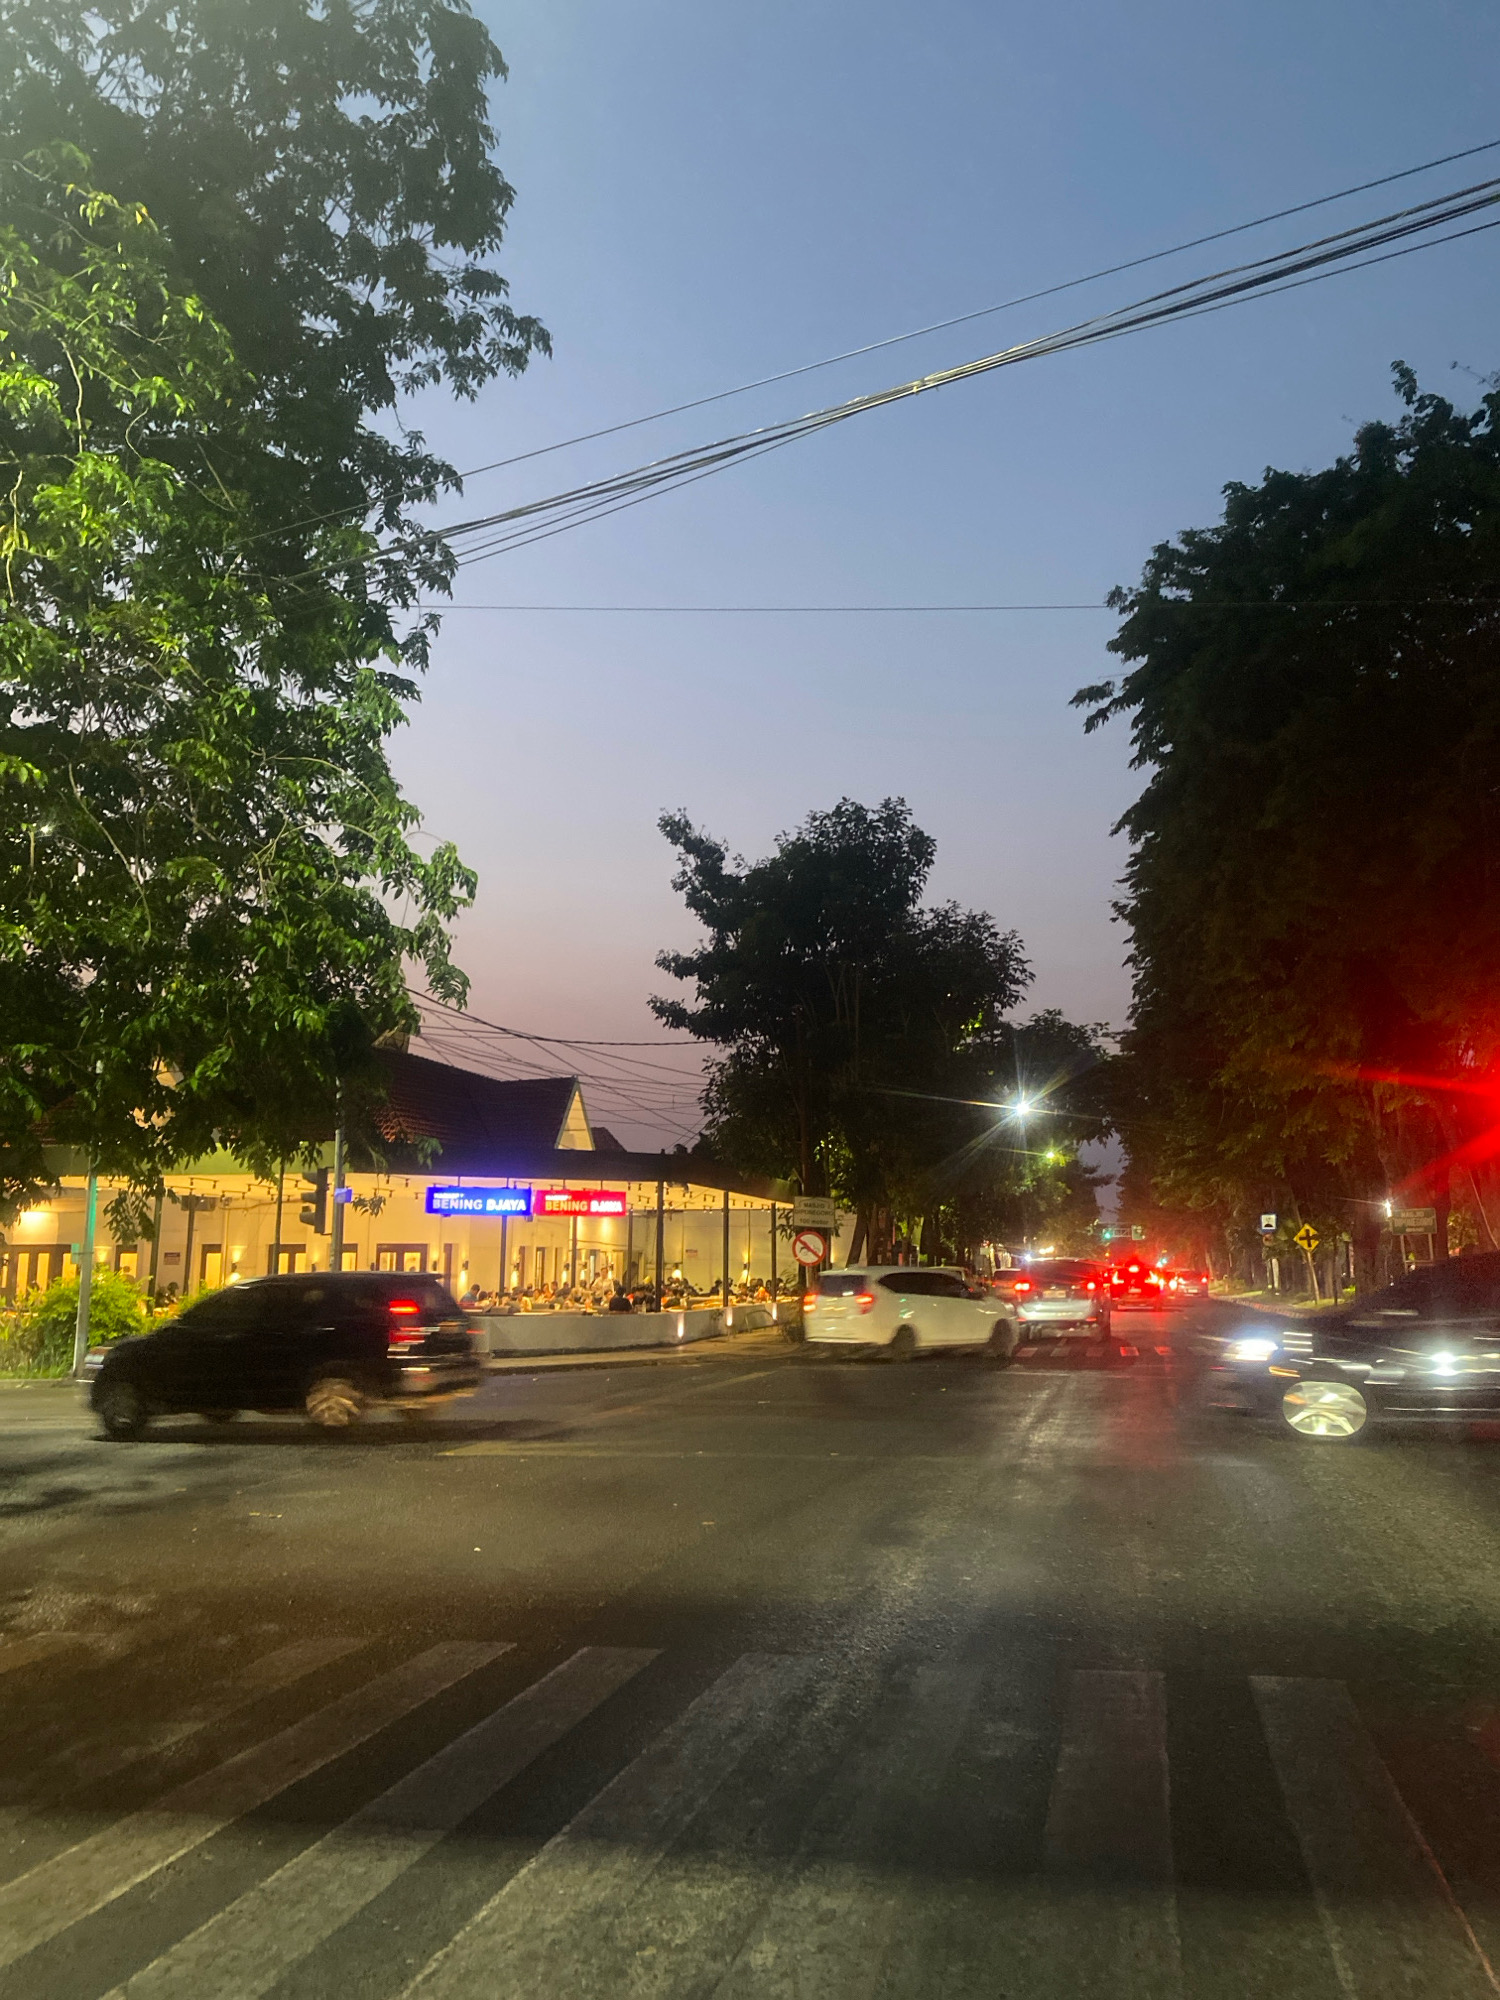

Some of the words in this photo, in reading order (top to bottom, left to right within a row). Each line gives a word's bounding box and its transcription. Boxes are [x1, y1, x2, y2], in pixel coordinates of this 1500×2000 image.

[432, 1199, 483, 1210] BENING
[486, 1199, 527, 1211] DJAYA
[545, 1200, 588, 1211] BENING
